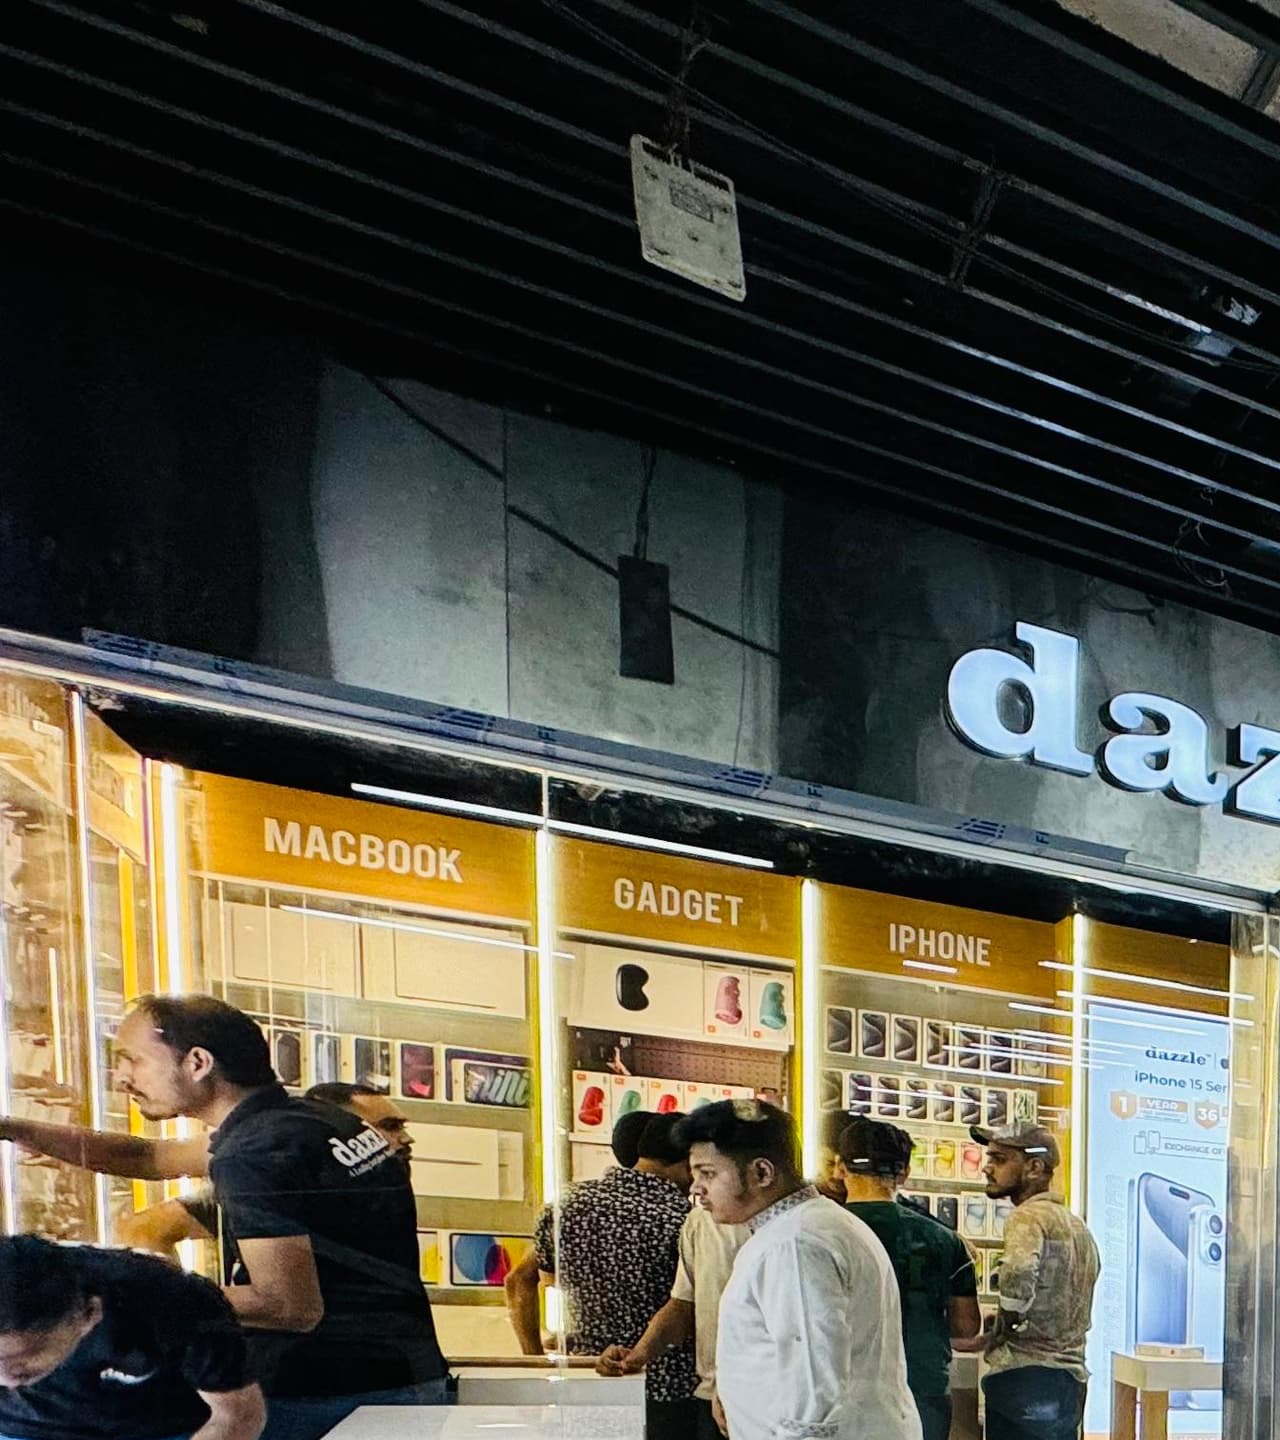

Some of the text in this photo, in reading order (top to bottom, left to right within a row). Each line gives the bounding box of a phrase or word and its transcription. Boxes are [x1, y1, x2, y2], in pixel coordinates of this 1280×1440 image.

[263, 816, 465, 884] MACBOOK
[613, 877, 743, 927] GADGET
[888, 922, 991, 967] IPHONE
[1145, 1046, 1206, 1066] dazzle
[1134, 1070, 1187, 1089] iPhone
[1190, 1078, 1203, 1091] 15
[1196, 1107, 1219, 1122] 36
